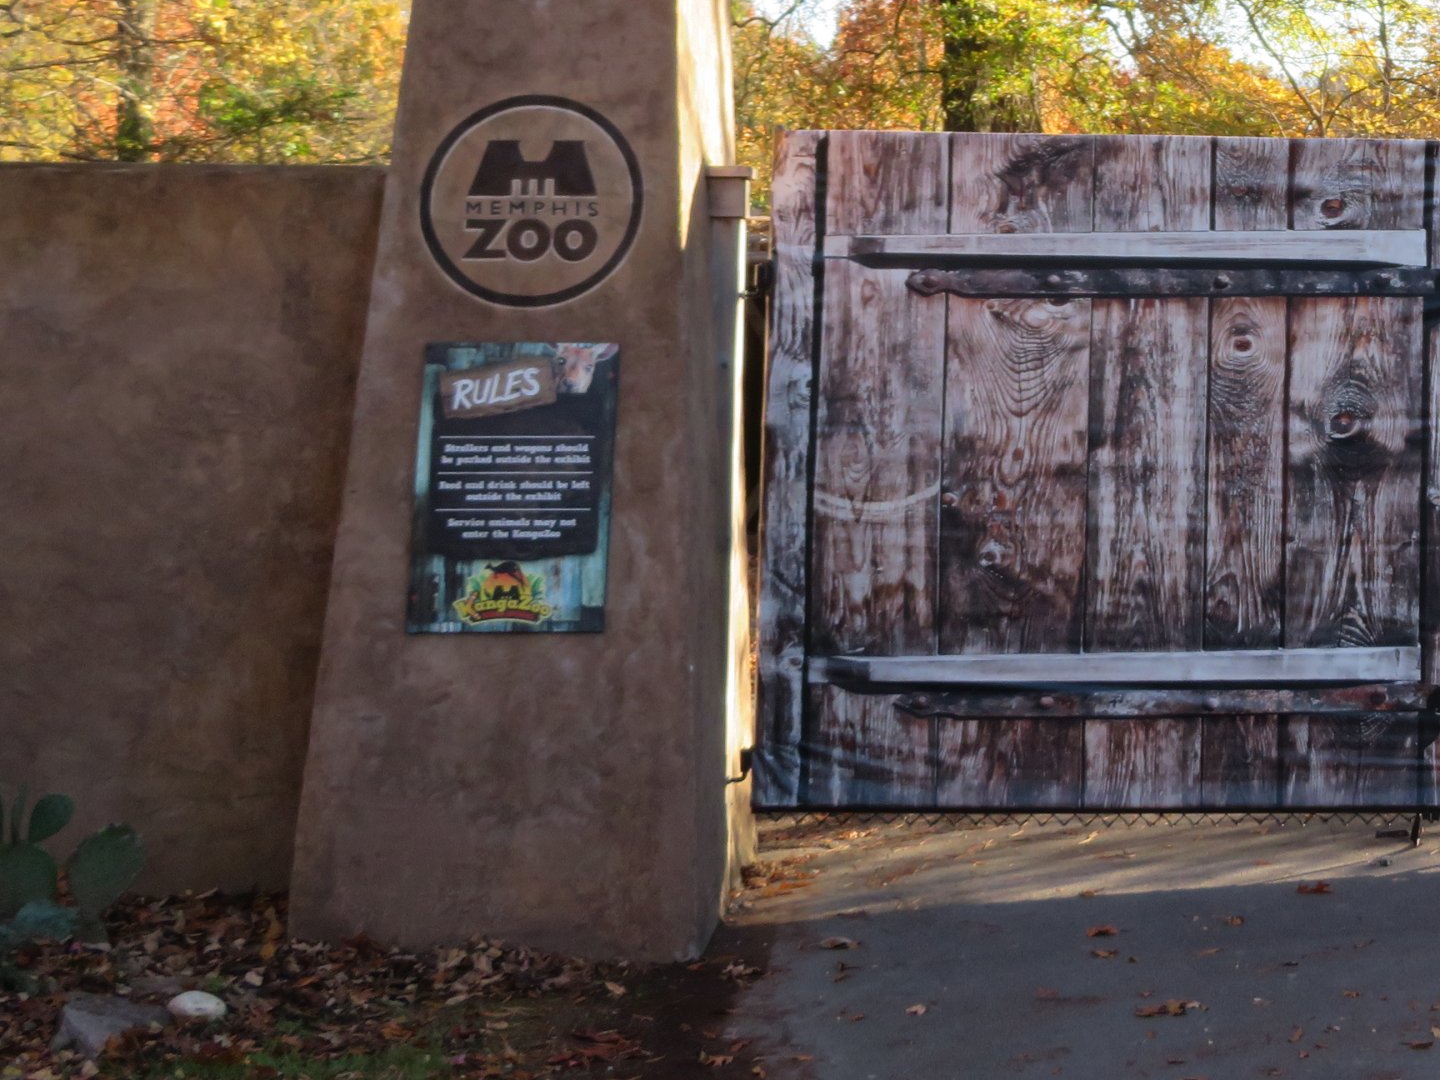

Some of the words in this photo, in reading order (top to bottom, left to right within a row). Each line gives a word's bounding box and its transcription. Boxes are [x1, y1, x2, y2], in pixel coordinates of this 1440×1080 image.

[465, 201, 599, 217] MEMPHIS
[461, 219, 598, 262] ZOO
[451, 367, 541, 411] RULES
[491, 443, 511, 452] and
[555, 443, 589, 452] should
[495, 455, 532, 464] outside
[534, 455, 552, 464] the
[554, 455, 591, 463] exhibit
[464, 481, 485, 489] and
[487, 480, 517, 489] drink
[519, 480, 553, 489] should
[465, 492, 502, 501] outside
[505, 492, 522, 500] the
[524, 492, 562, 500] exhibit
[447, 518, 485, 527] Service
[488, 518, 530, 526] animals
[533, 519, 557, 528] may
[462, 530, 489, 538] enter
[491, 530, 509, 538] the
[454, 592, 551, 620] KangaZoo
